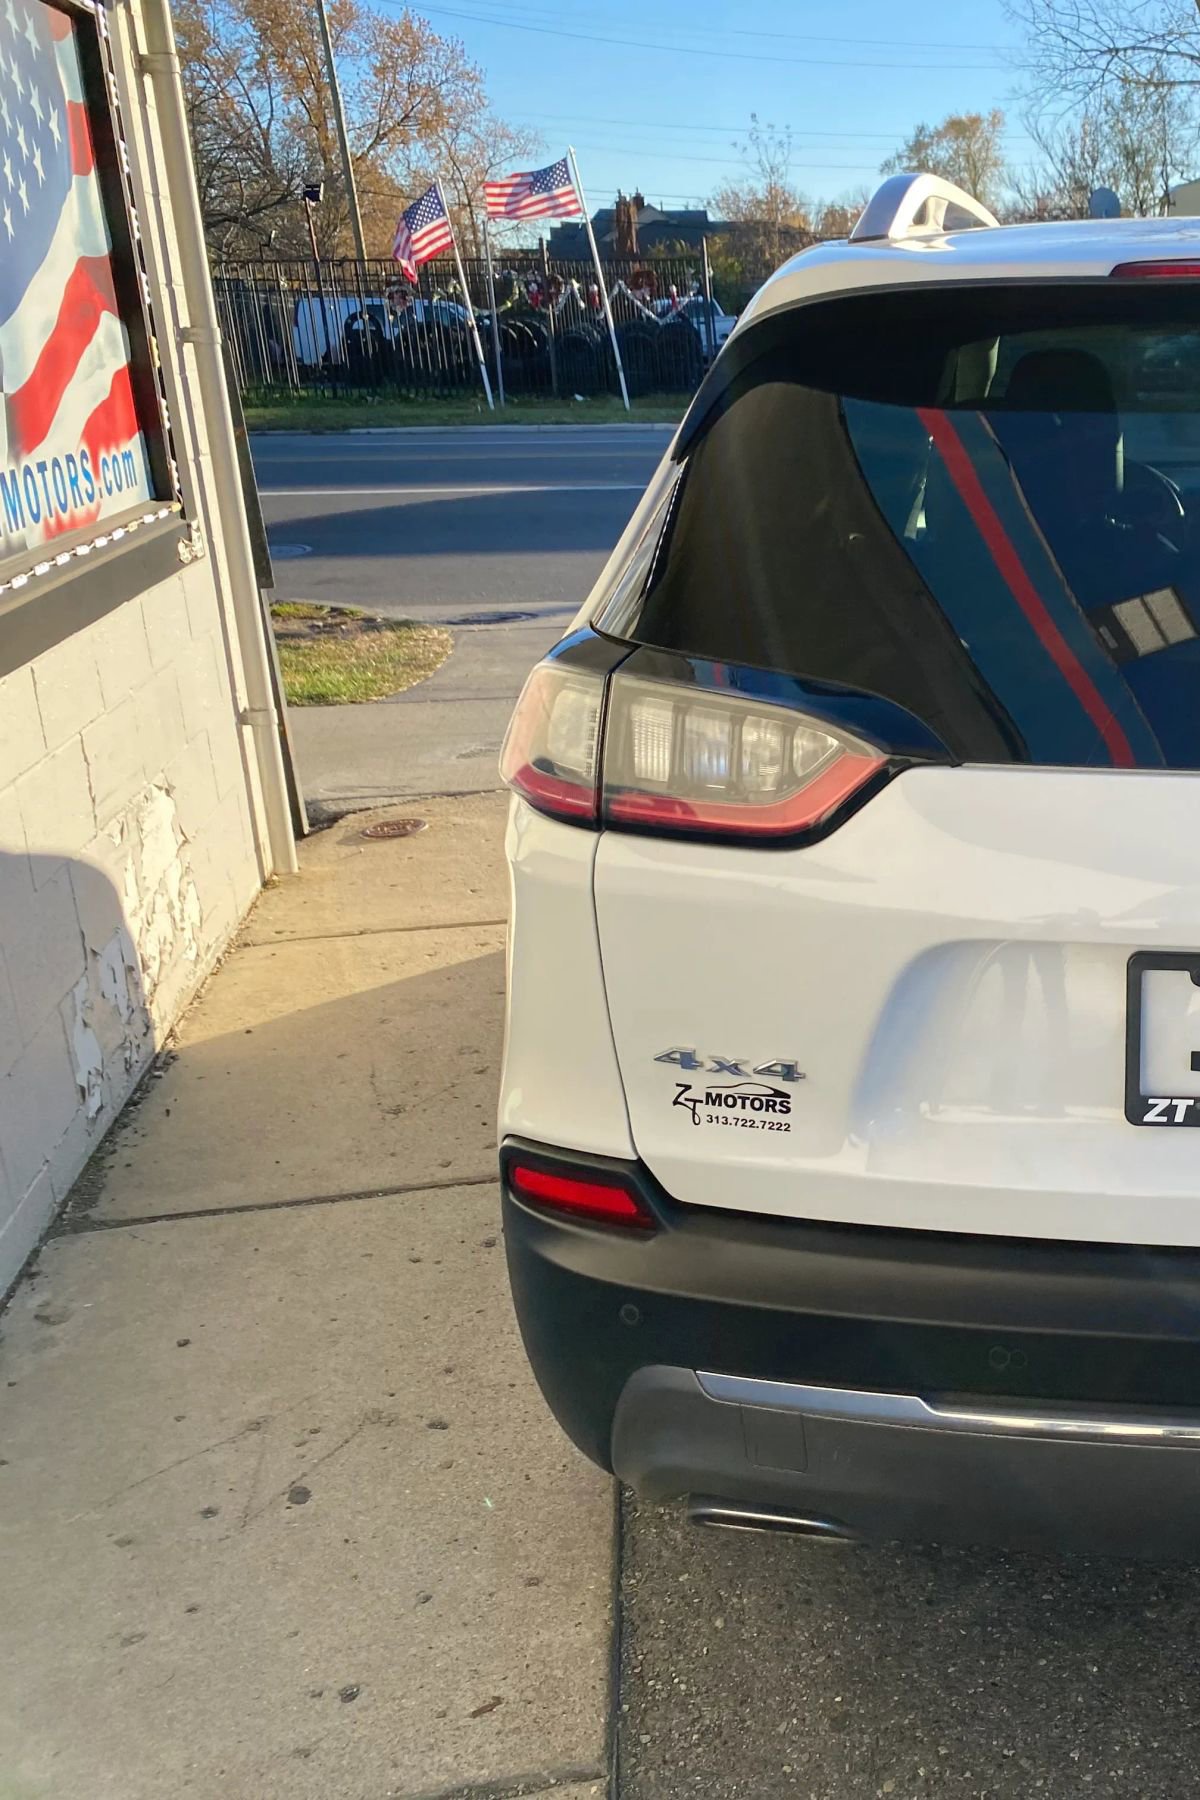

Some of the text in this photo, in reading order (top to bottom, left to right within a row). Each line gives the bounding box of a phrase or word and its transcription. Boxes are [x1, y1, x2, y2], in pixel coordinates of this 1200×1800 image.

[705, 1091, 792, 1114] MOTORS
[1143, 1098, 1195, 1123] ZT
[706, 1114, 791, 1132] 313.722.7222
